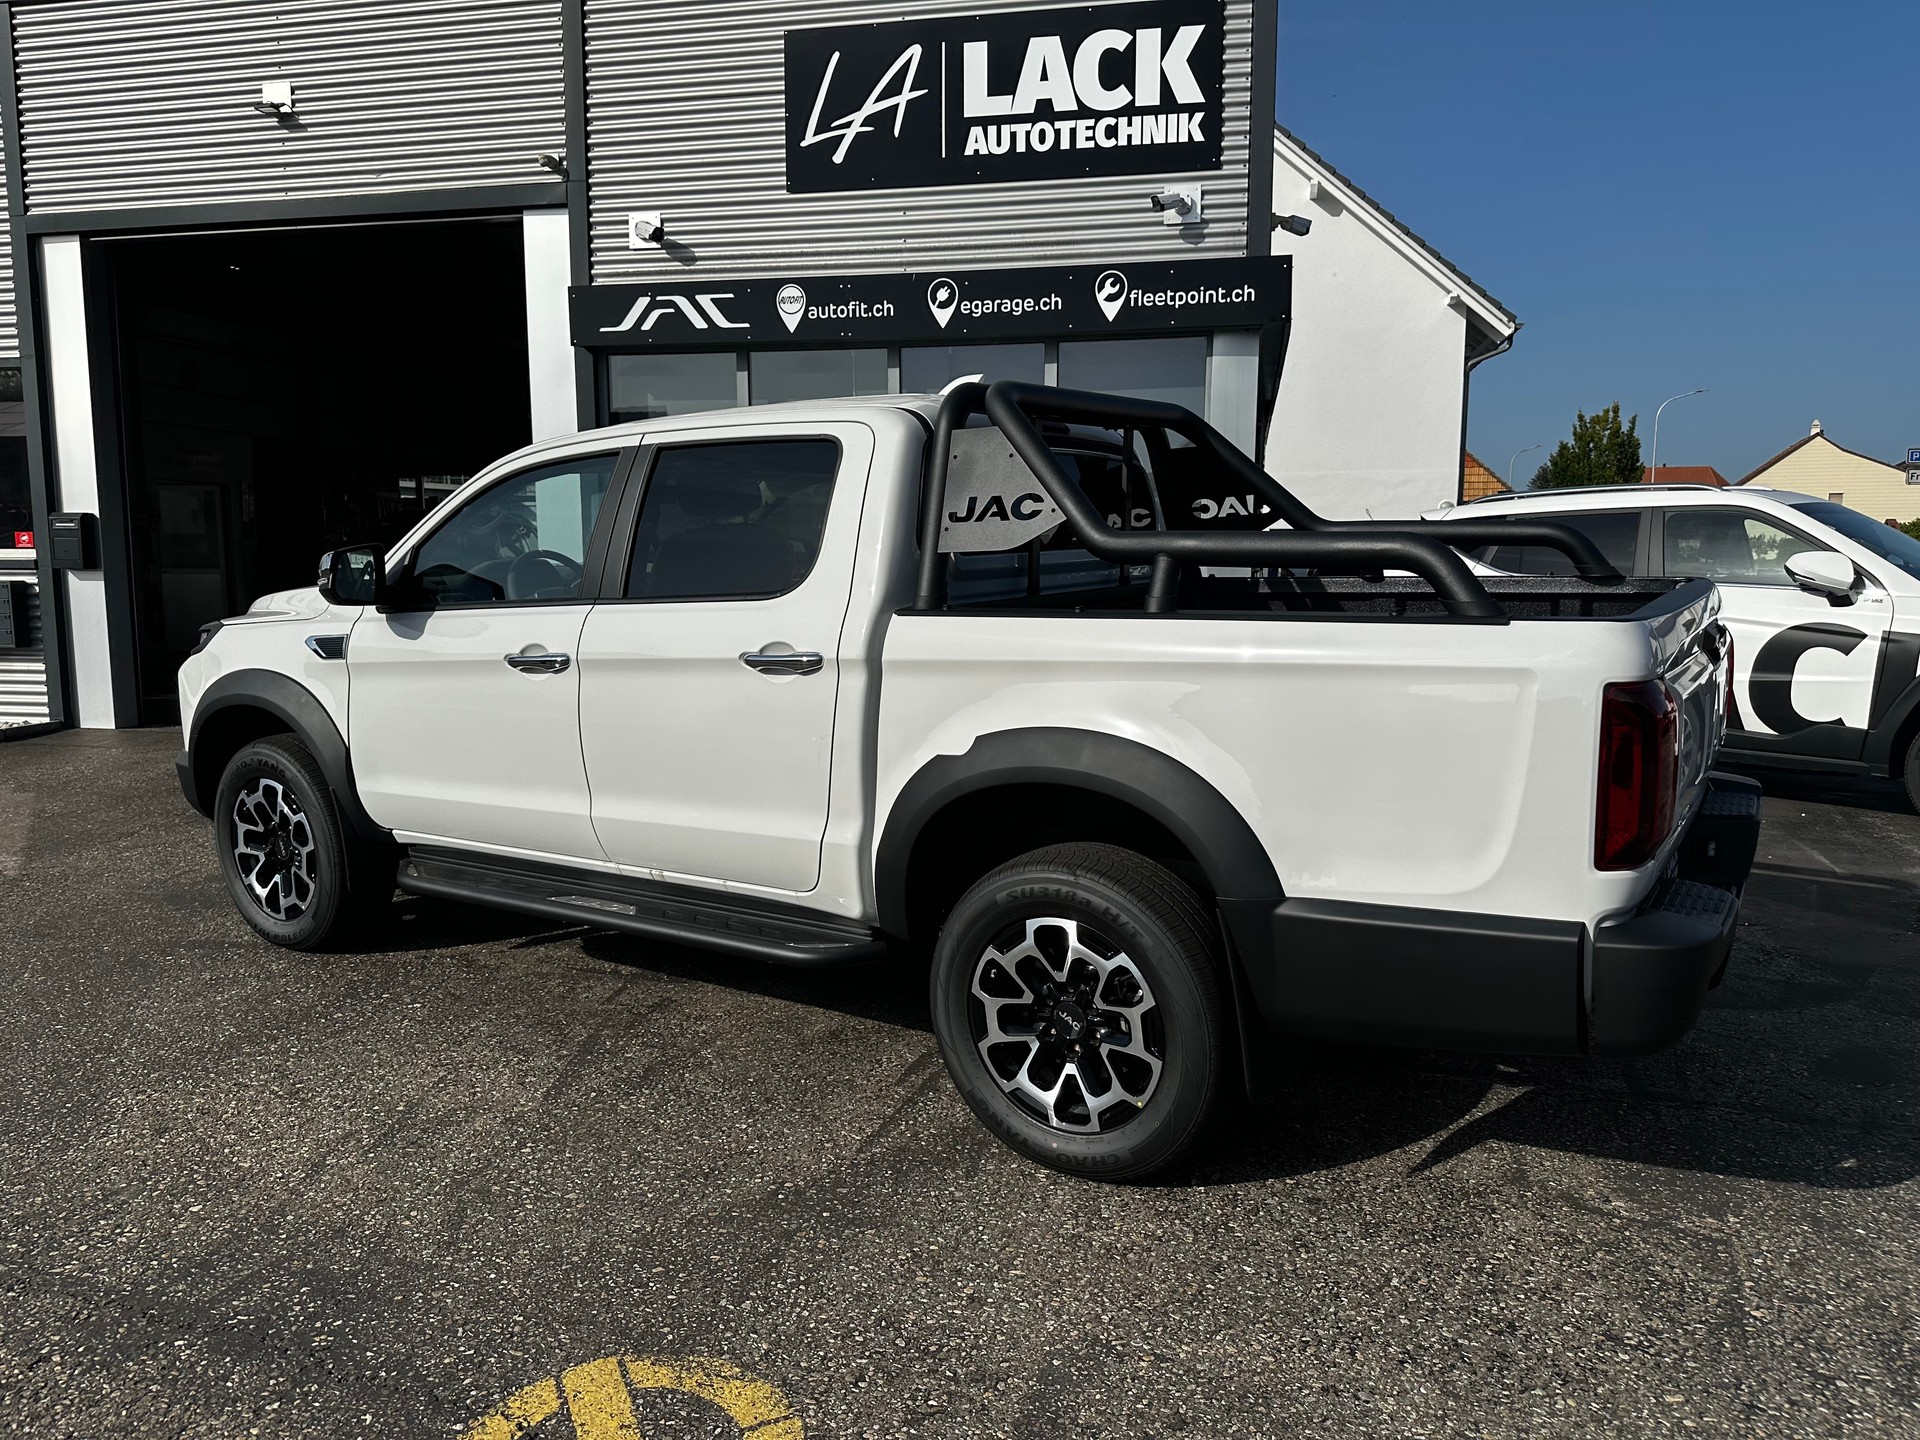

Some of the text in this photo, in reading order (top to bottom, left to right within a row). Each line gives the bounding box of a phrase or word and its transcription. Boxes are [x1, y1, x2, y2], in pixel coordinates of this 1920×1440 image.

[963, 24, 1206, 118] LACK
[963, 112, 1206, 157] AUTOTECHNIK
[808, 300, 895, 319] autofit.ch
[959, 294, 1063, 317] egarage.ch
[1128, 284, 1256, 311] fleetpoint.ch
[948, 493, 1045, 523] JAC
[1058, 1011, 1081, 1031] JAC
